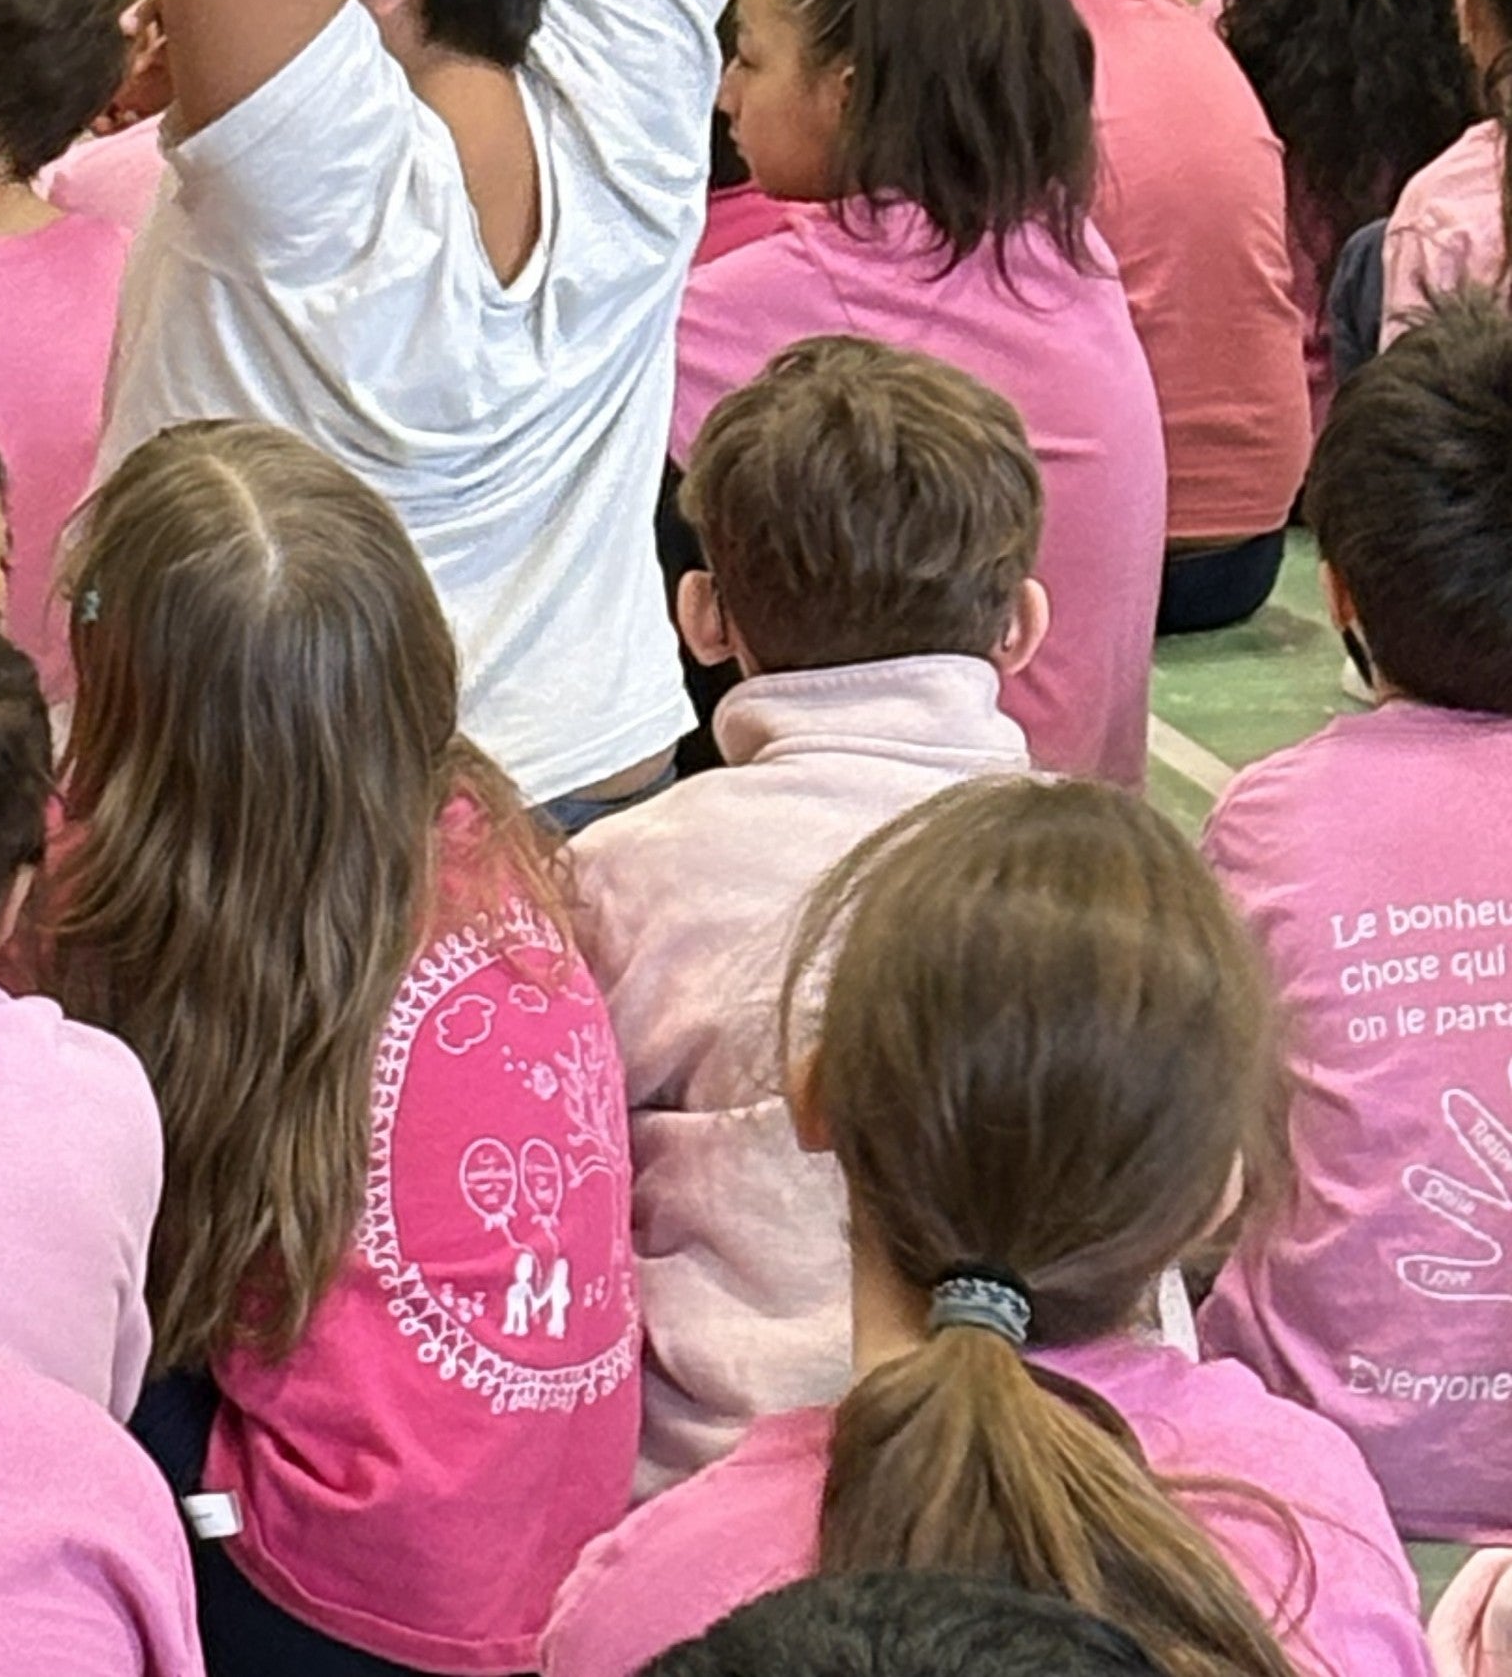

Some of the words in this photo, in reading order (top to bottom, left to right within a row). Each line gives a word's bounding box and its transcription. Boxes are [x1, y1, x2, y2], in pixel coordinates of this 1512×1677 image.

[1329, 911, 1378, 950] Le
[1340, 953, 1440, 996] chose
[1450, 942, 1506, 985] qui
[1347, 1015, 1388, 1044] on
[1396, 1005, 1426, 1038] le
[1434, 1001, 1512, 1036] part
[1348, 1354, 1512, 1405] Everyone
